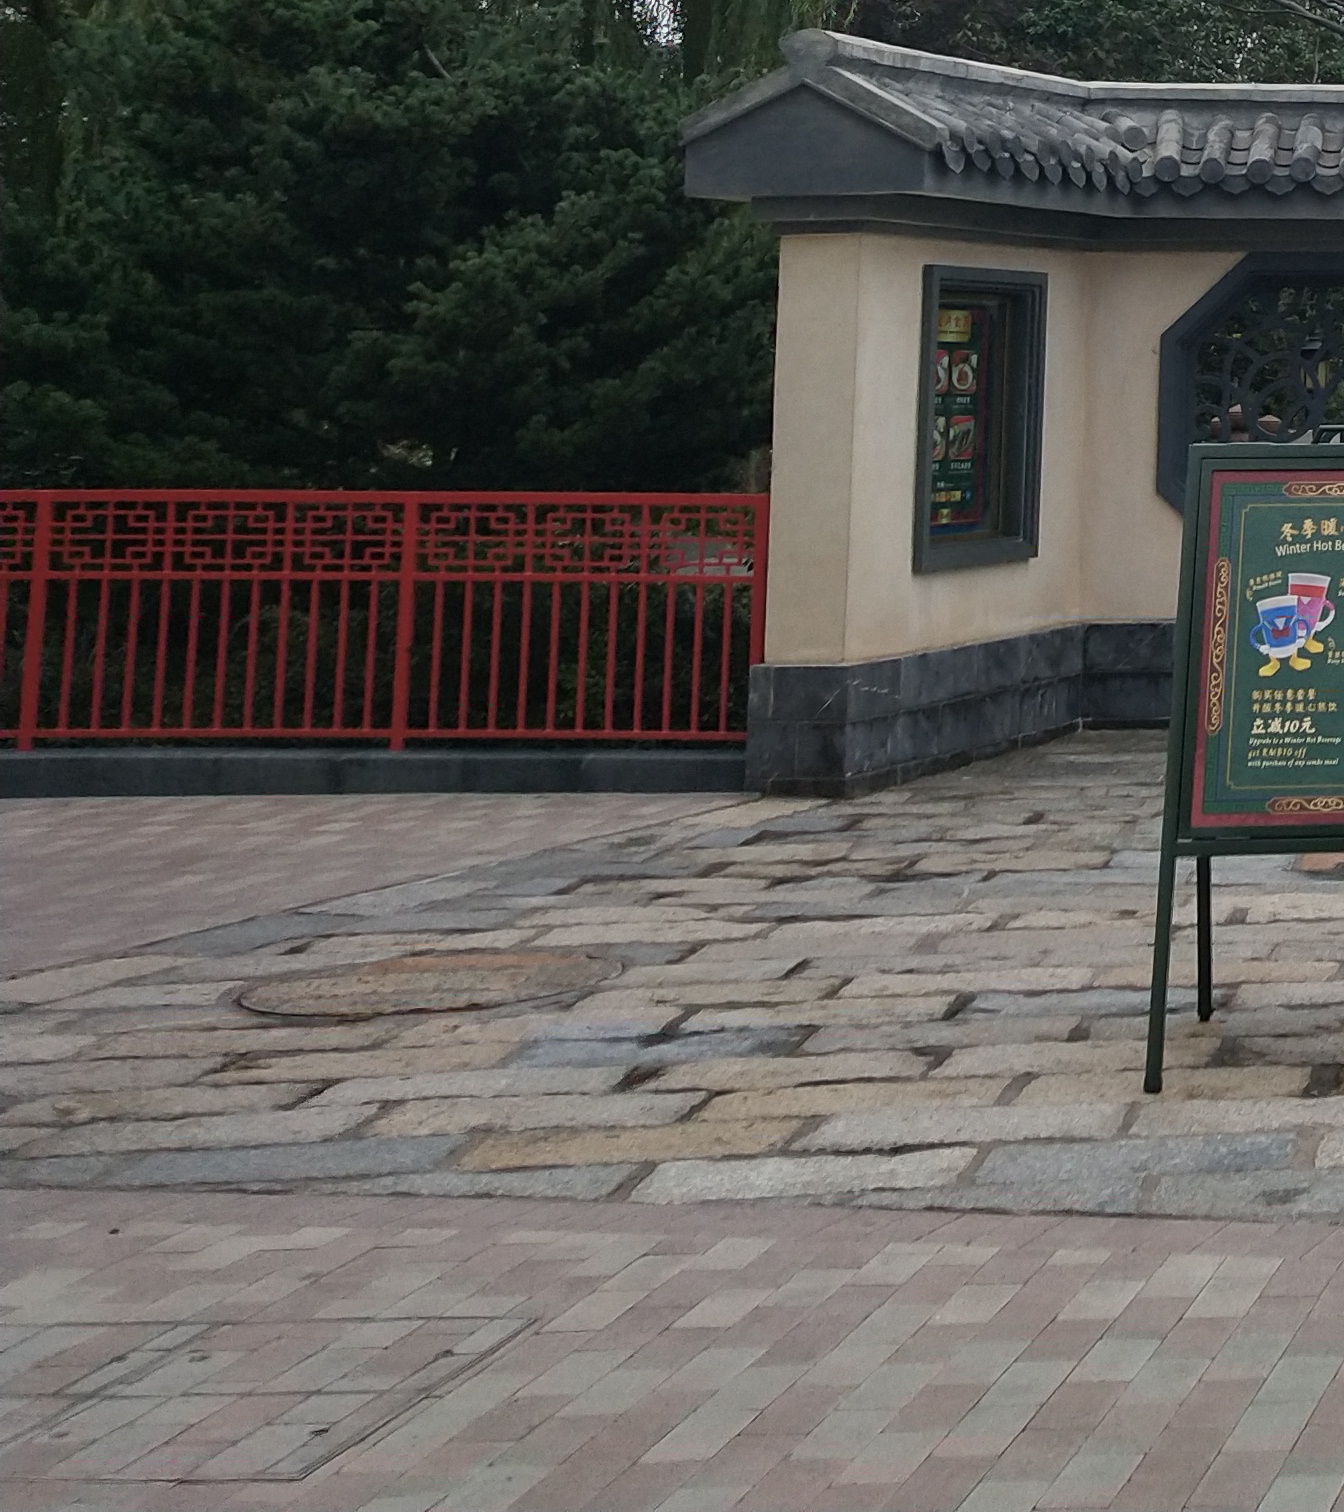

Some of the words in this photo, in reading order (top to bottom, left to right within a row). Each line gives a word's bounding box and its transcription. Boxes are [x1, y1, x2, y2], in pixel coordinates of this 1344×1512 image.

[1275, 542, 1312, 557] Winter
[1313, 540, 1333, 551] Hot
[1251, 716, 1316, 734] 立减10元
